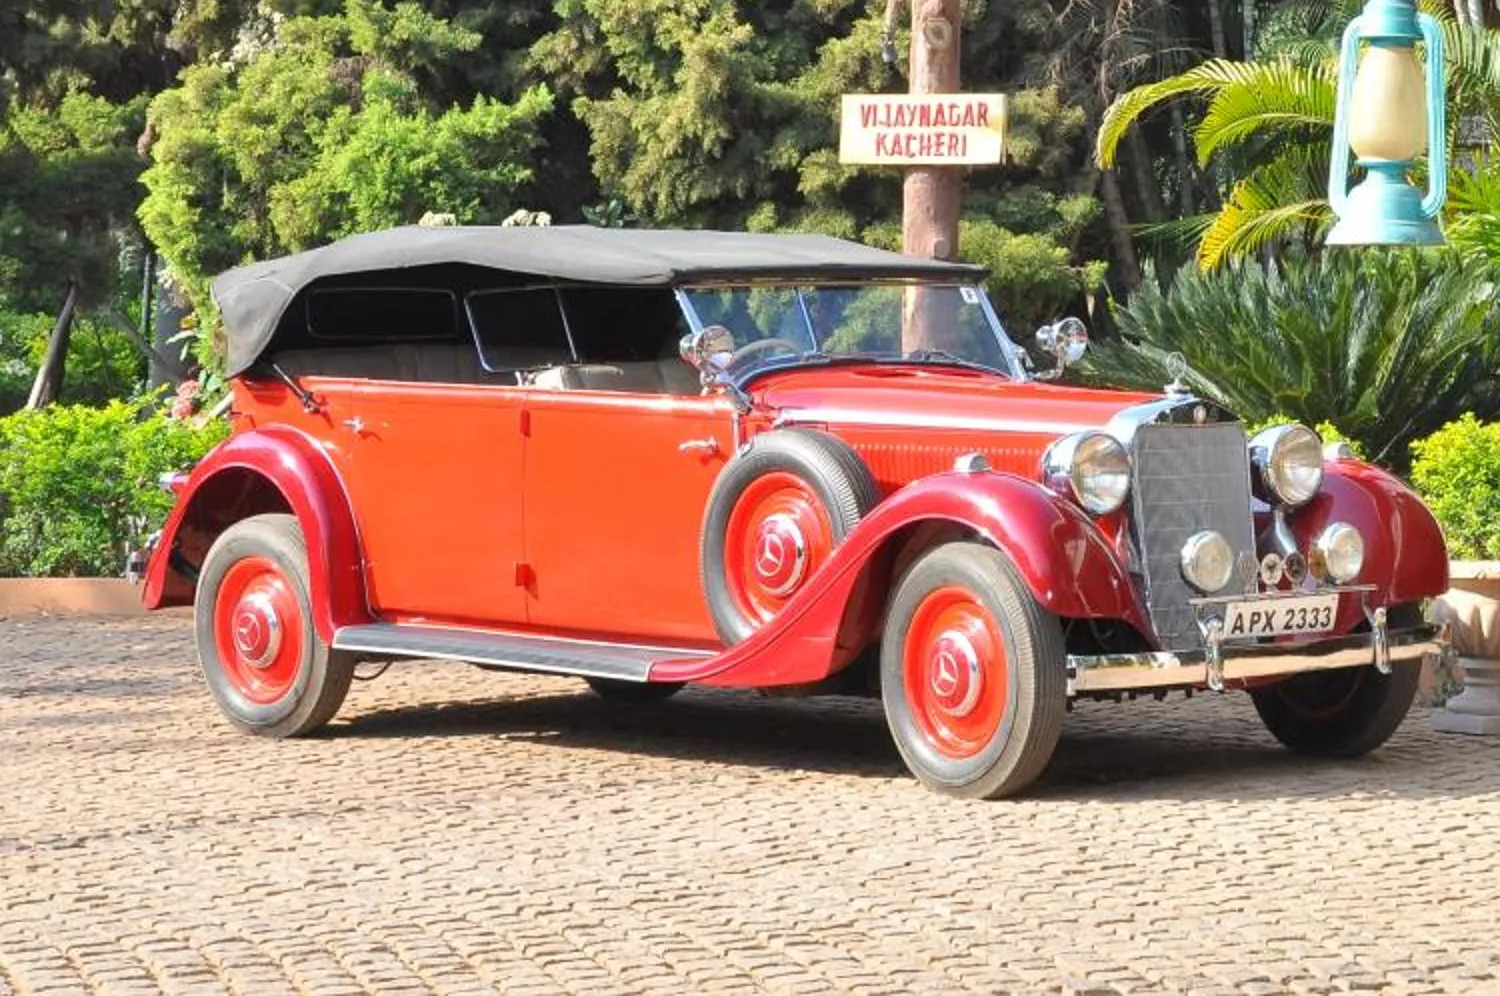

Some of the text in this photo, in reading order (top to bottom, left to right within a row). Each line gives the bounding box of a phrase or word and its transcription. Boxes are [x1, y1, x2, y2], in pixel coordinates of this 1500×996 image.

[860, 102, 990, 129] VIJAYNAGAR
[874, 132, 968, 158] KACHERI
[1231, 606, 1332, 635] APX 2333
